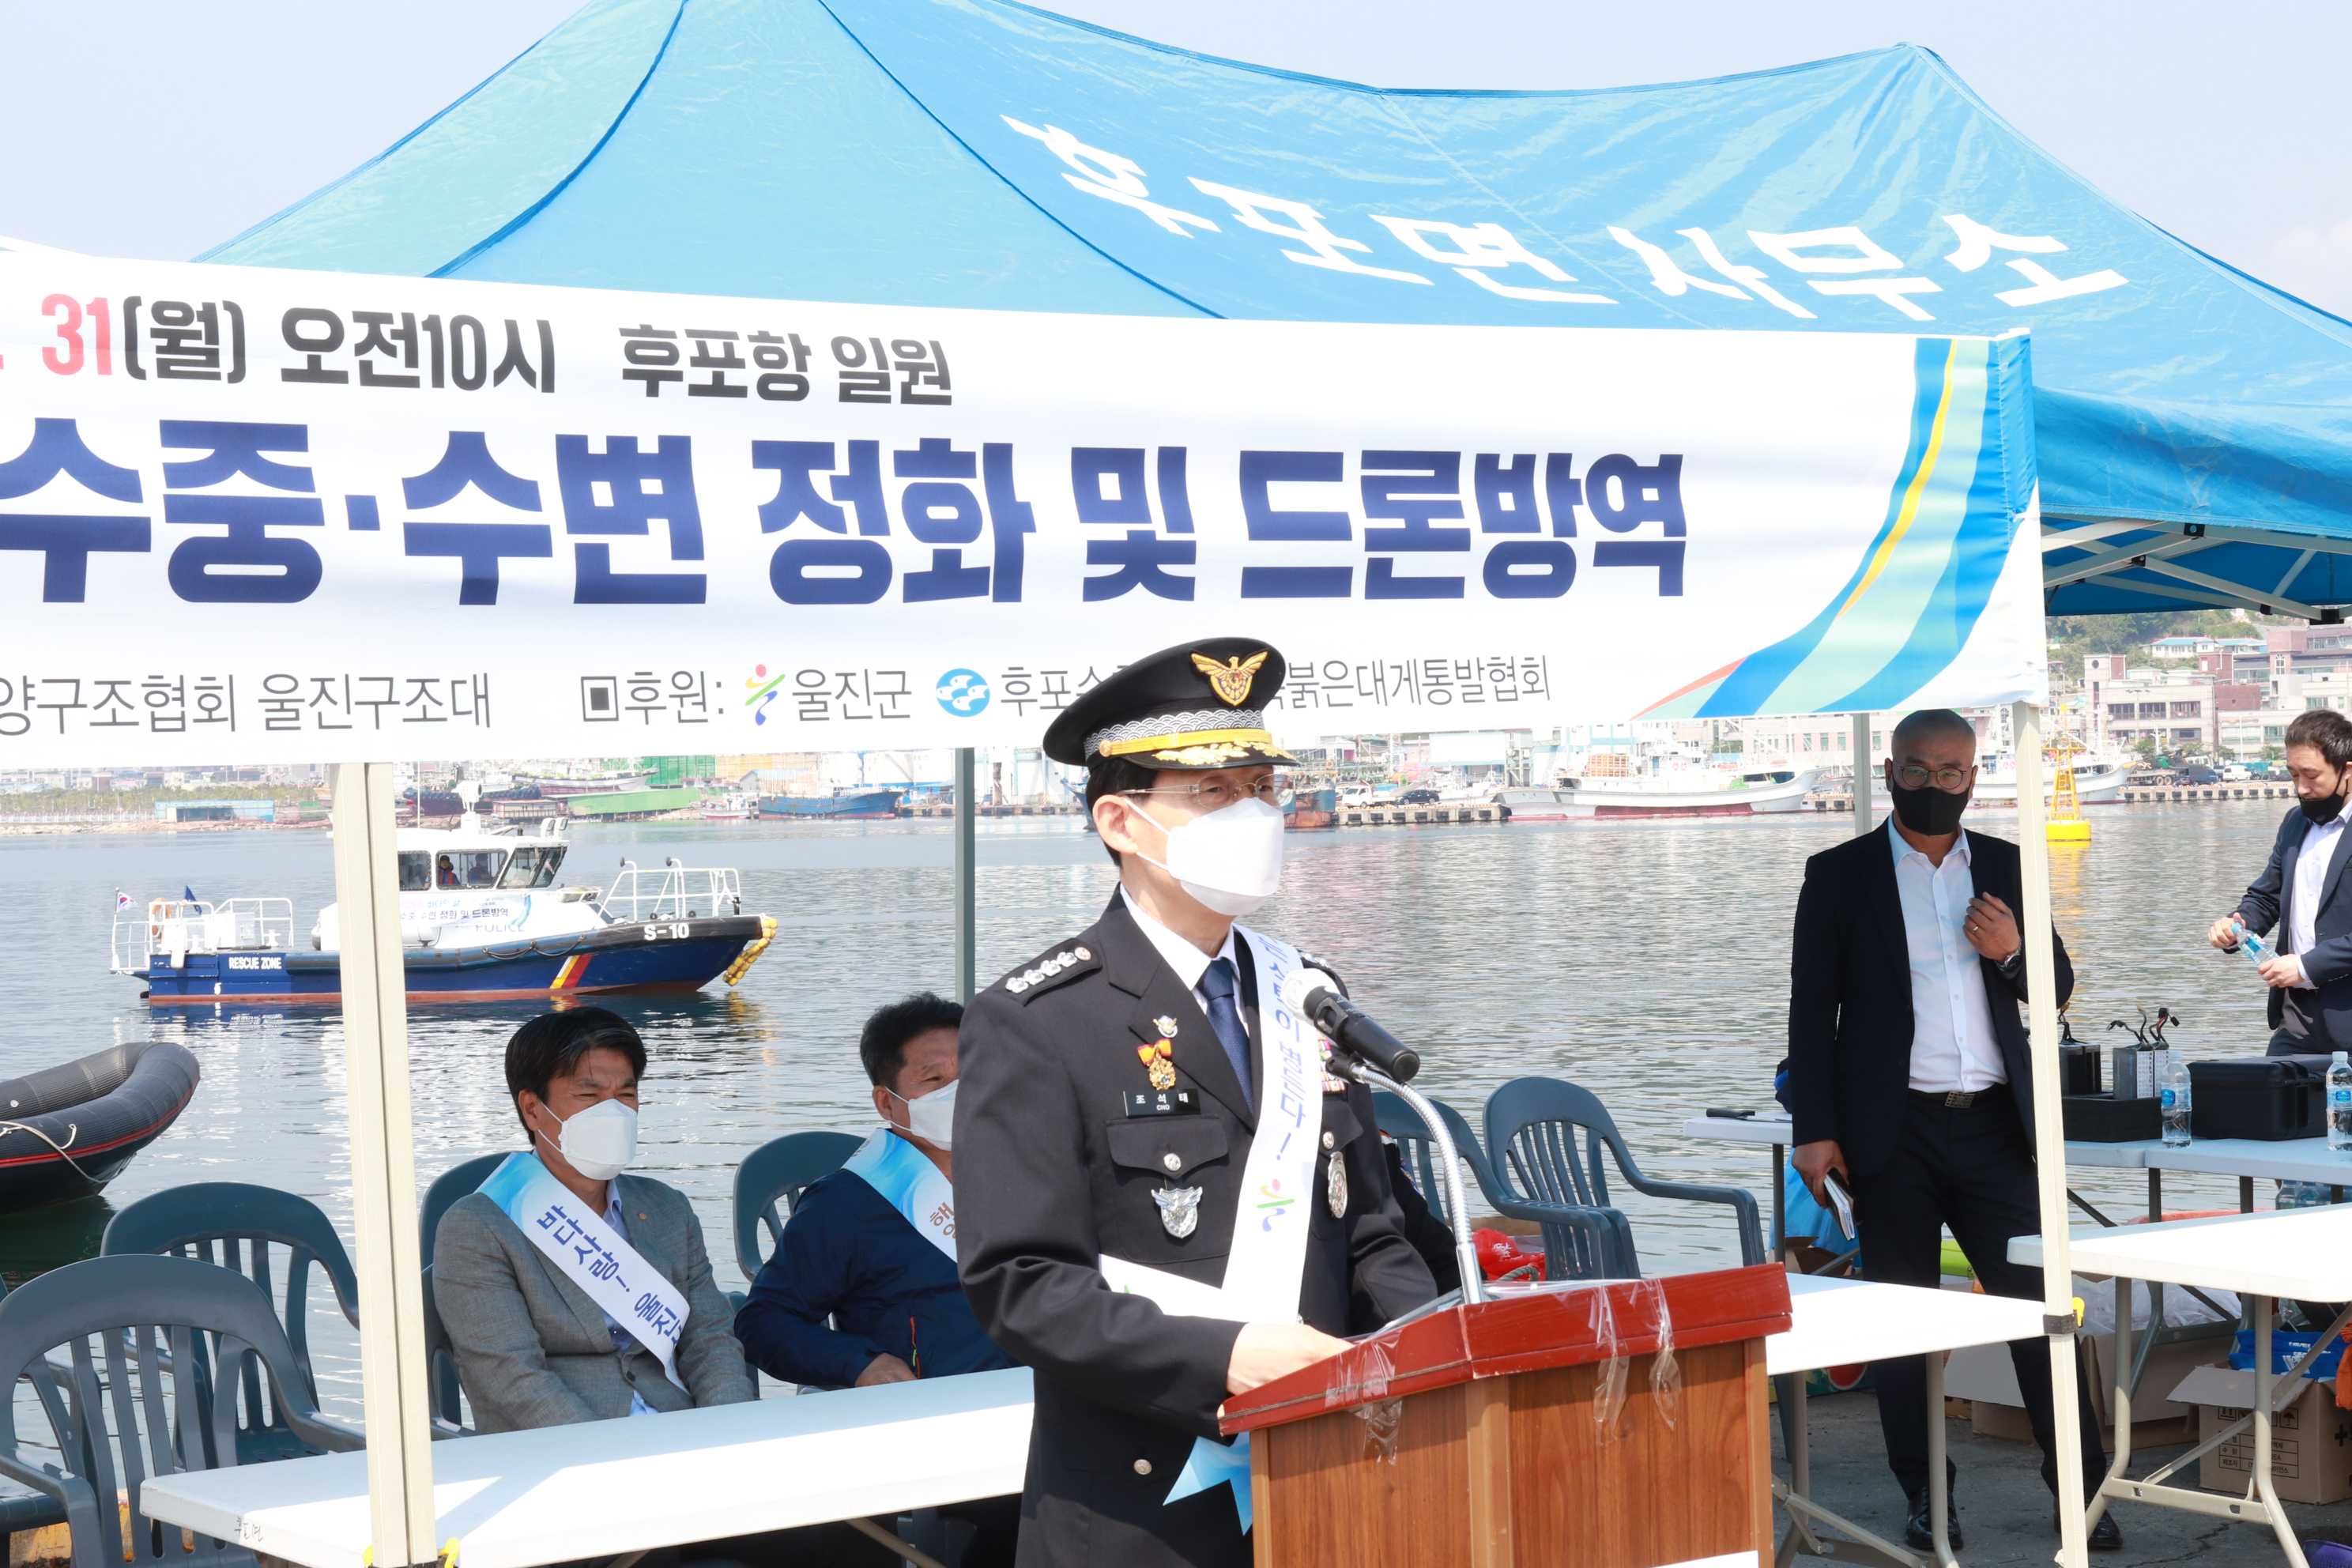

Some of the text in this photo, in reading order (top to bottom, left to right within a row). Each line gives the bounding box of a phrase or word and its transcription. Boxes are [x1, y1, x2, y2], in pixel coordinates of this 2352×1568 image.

[1001, 115, 2129, 320] 후포면 사무소
[42, 293, 952, 405] 31(월) 오전10시 후포항 일원
[752, 438, 1036, 605] 정화
[1071, 447, 1196, 601] 및
[1239, 450, 1687, 600] 드론방역
[258, 673, 491, 730] 울진구조대
[792, 669, 912, 721] 울진군
[1001, 665, 1129, 717] 후포수
[428, 899, 450, 908] 바다의
[439, 910, 458, 920] 정화
[461, 910, 469, 920] 및
[472, 908, 509, 918] 드론방역
[644, 922, 690, 941] S-10
[228, 956, 282, 970] RESCUE ZONE
[537, 1204, 630, 1293] 바다사랑!
